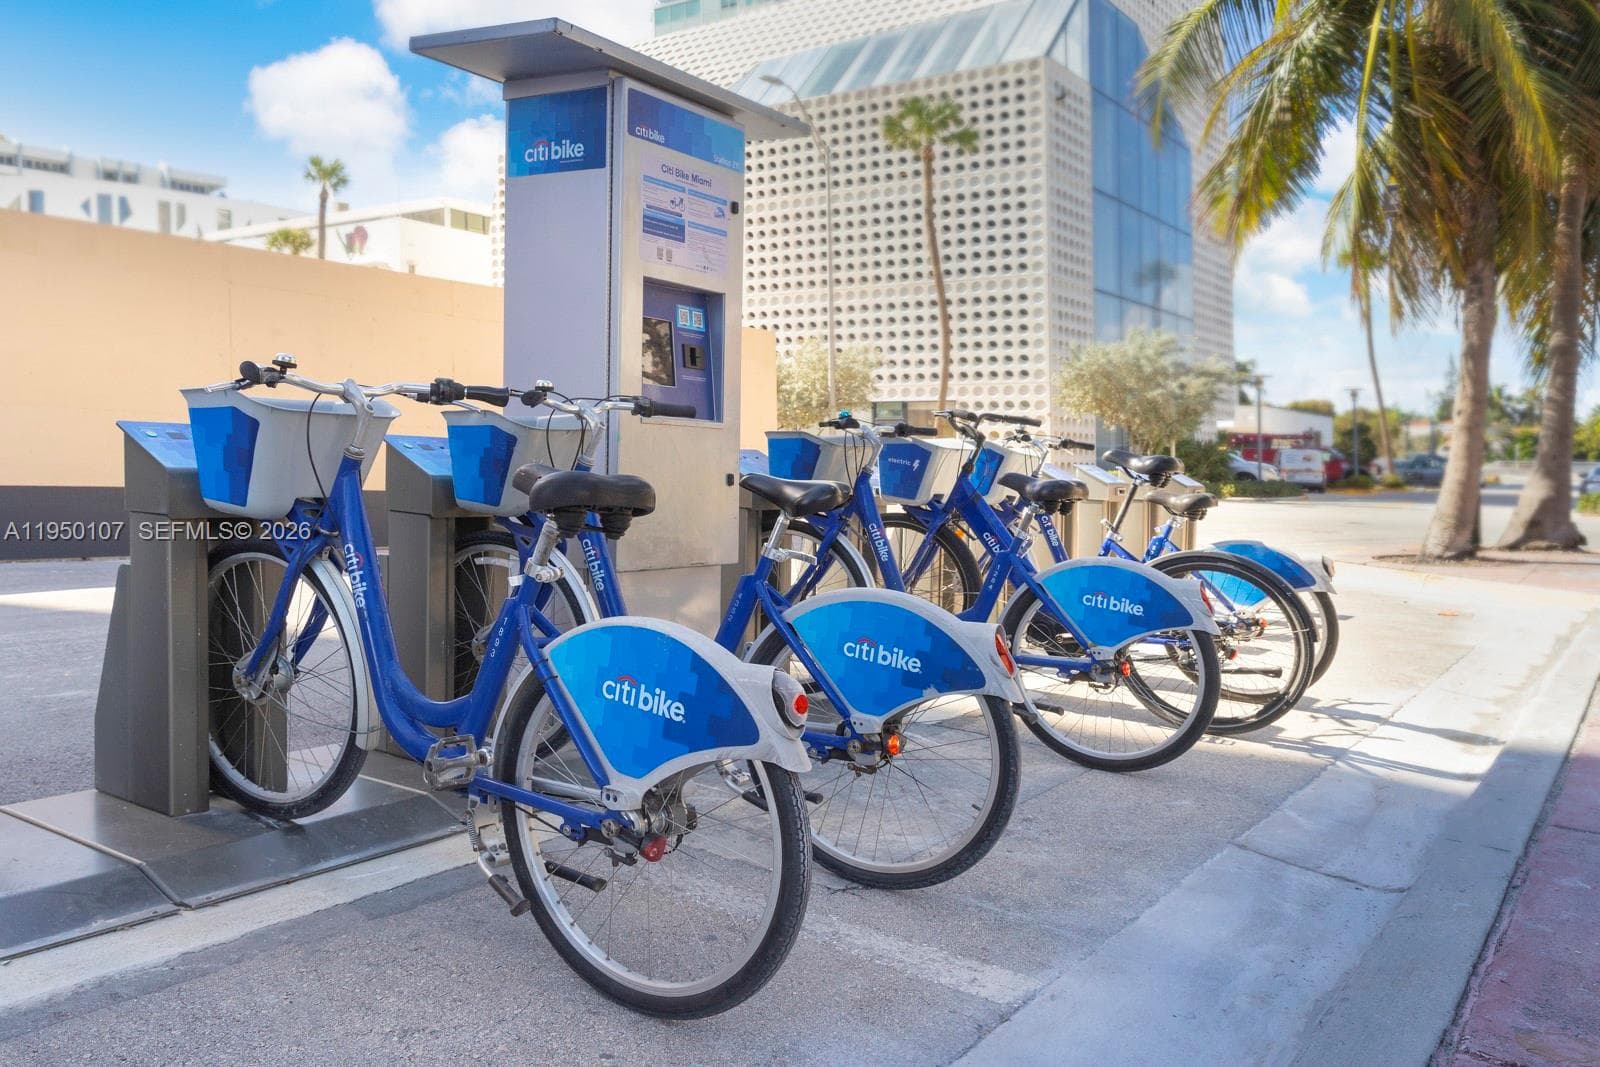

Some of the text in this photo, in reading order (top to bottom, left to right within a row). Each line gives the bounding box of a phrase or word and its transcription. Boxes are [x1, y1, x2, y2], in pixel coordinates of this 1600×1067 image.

[661, 163, 674, 175] Citi
[675, 168, 690, 181] Bike
[691, 173, 712, 188] Miami
[888, 457, 911, 466] electric
